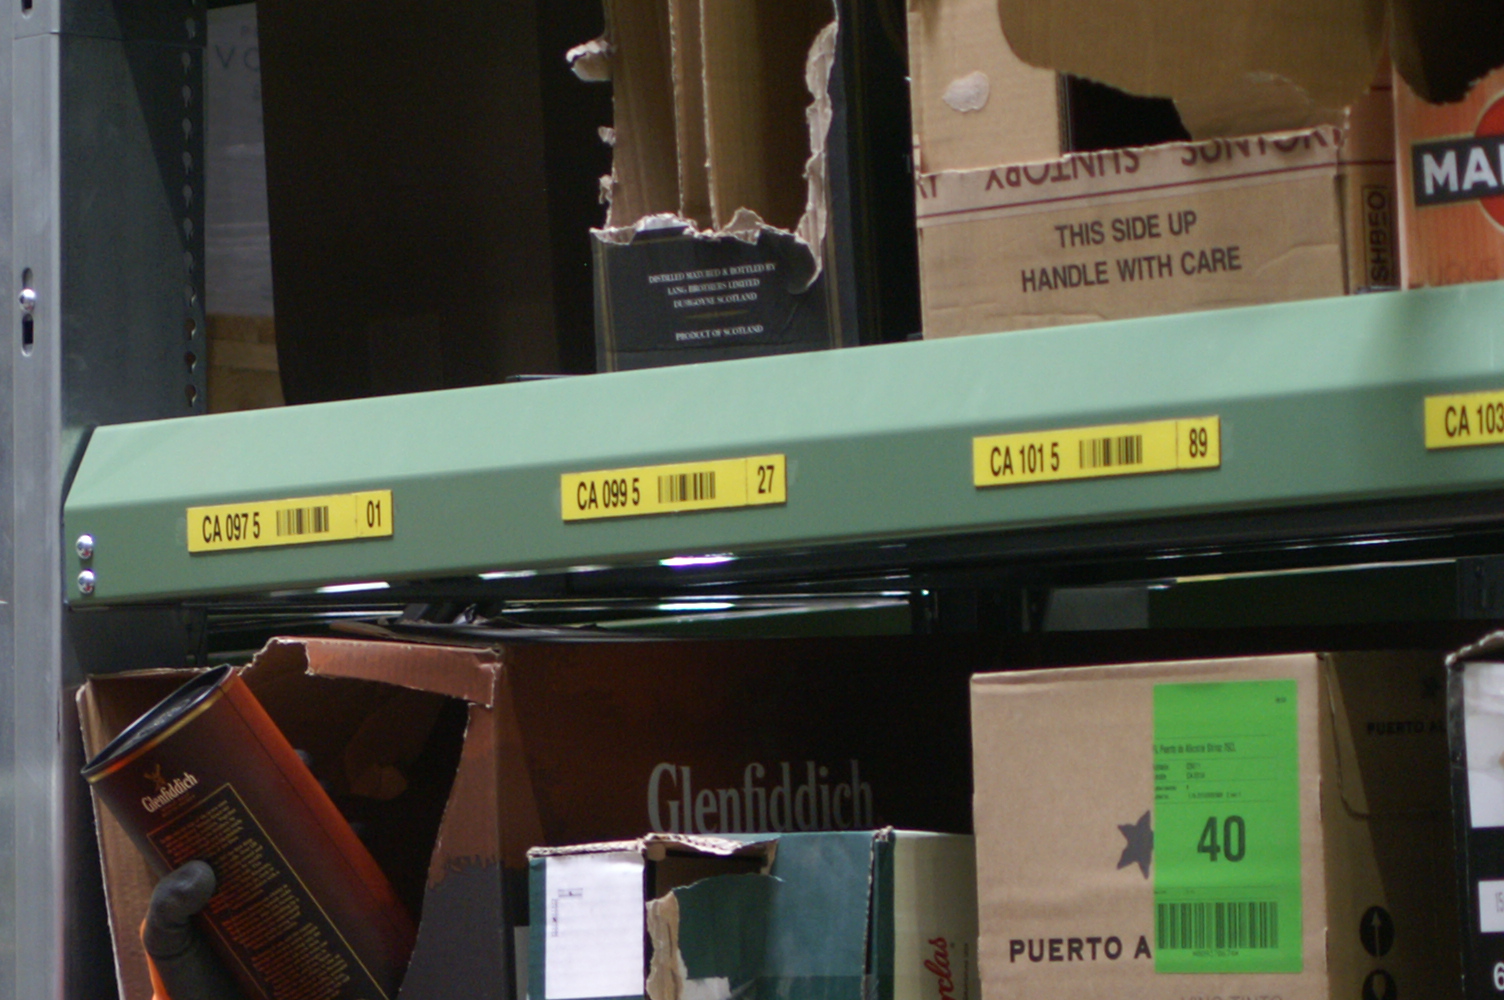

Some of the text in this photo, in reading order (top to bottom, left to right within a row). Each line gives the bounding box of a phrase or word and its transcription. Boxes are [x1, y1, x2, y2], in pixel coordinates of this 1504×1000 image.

[1054, 210, 1198, 248] THIS SIDE UP
[1021, 246, 1243, 293] HANDLE WITH CARE
[1444, 404, 1471, 438] CA
[990, 442, 1059, 477] CA 101 5
[1188, 428, 1208, 458] 89
[576, 478, 641, 511] CA 099 5
[757, 466, 775, 495] 27
[202, 511, 260, 544] CA 097 5
[366, 500, 382, 528] 01
[141, 771, 198, 814] Glenfiddich
[647, 759, 874, 834] Glenfiddich
[1197, 815, 1246, 862] 40
[1010, 936, 1123, 963] PUERTO
